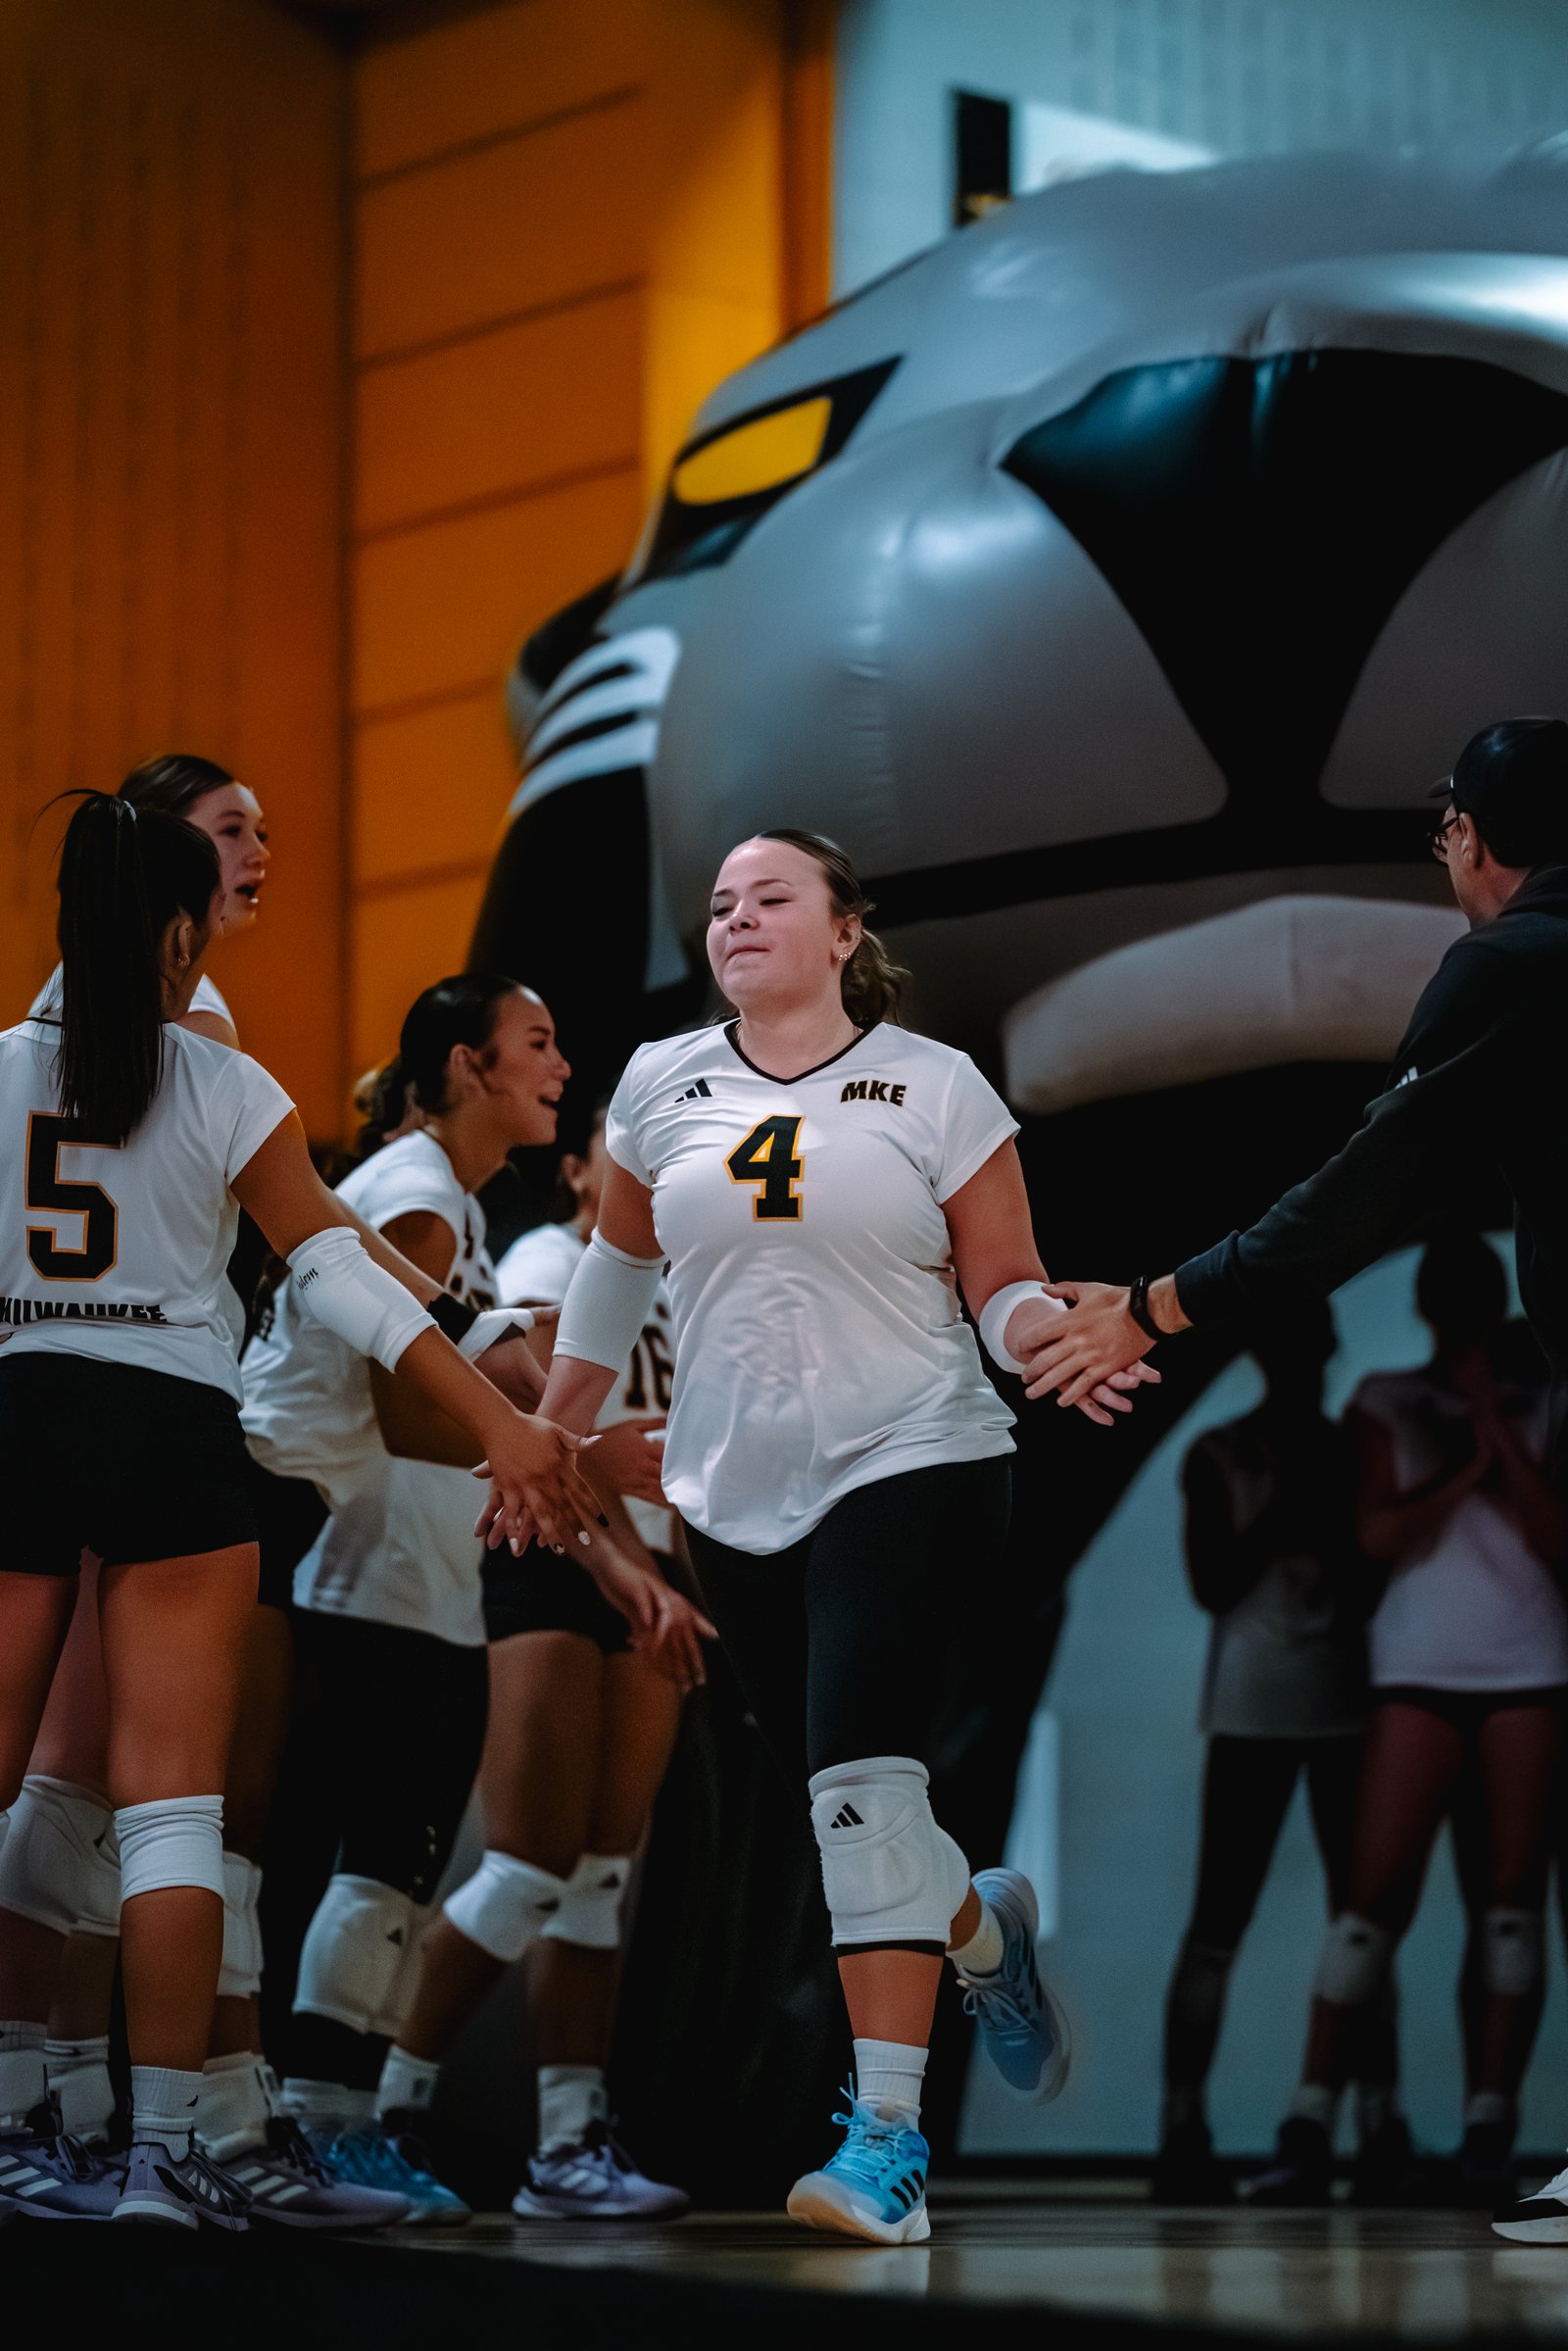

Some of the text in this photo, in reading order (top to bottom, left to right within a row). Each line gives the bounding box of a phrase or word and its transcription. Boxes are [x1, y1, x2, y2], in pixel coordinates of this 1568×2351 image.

[840, 1079, 906, 1106] MKE
[25, 1109, 119, 1283] 5
[723, 1114, 805, 1222] 4
